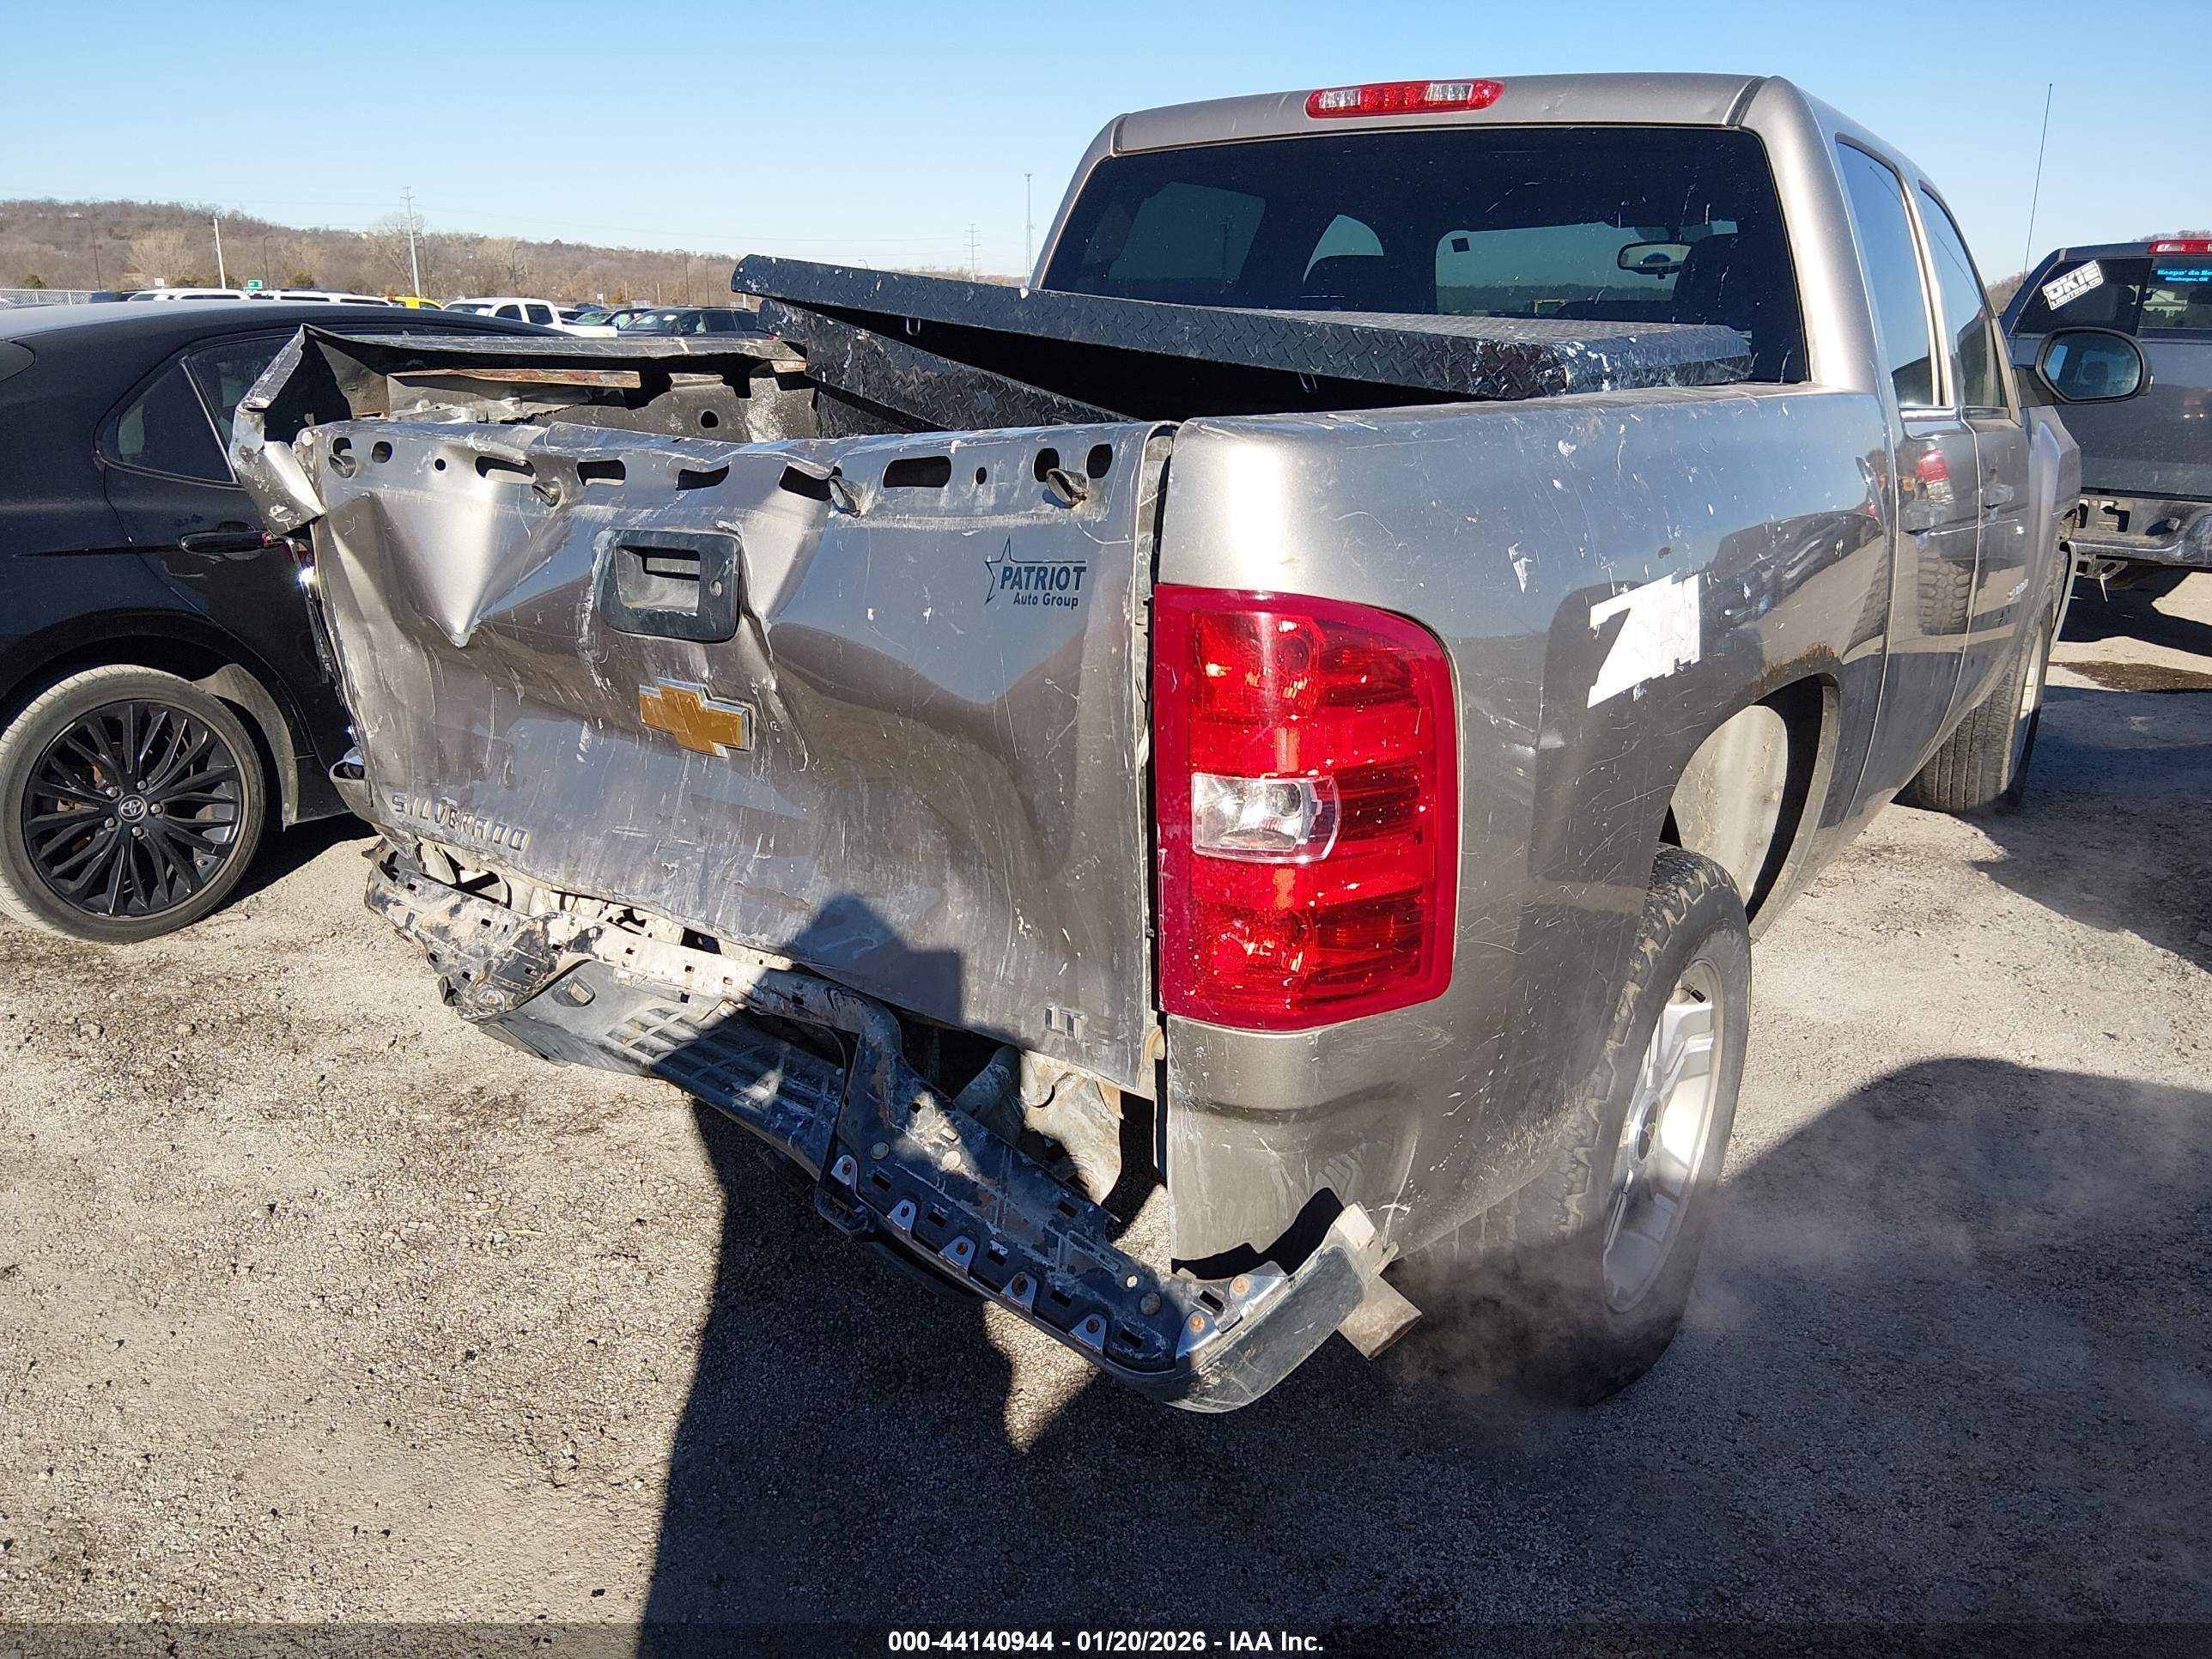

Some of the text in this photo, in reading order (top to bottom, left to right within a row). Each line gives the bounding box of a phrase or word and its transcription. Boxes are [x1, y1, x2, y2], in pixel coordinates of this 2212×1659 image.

[1000, 566, 1086, 591] PATRIOT
[1013, 592, 1079, 611] Auto Group
[392, 793, 533, 851] SILVERADO
